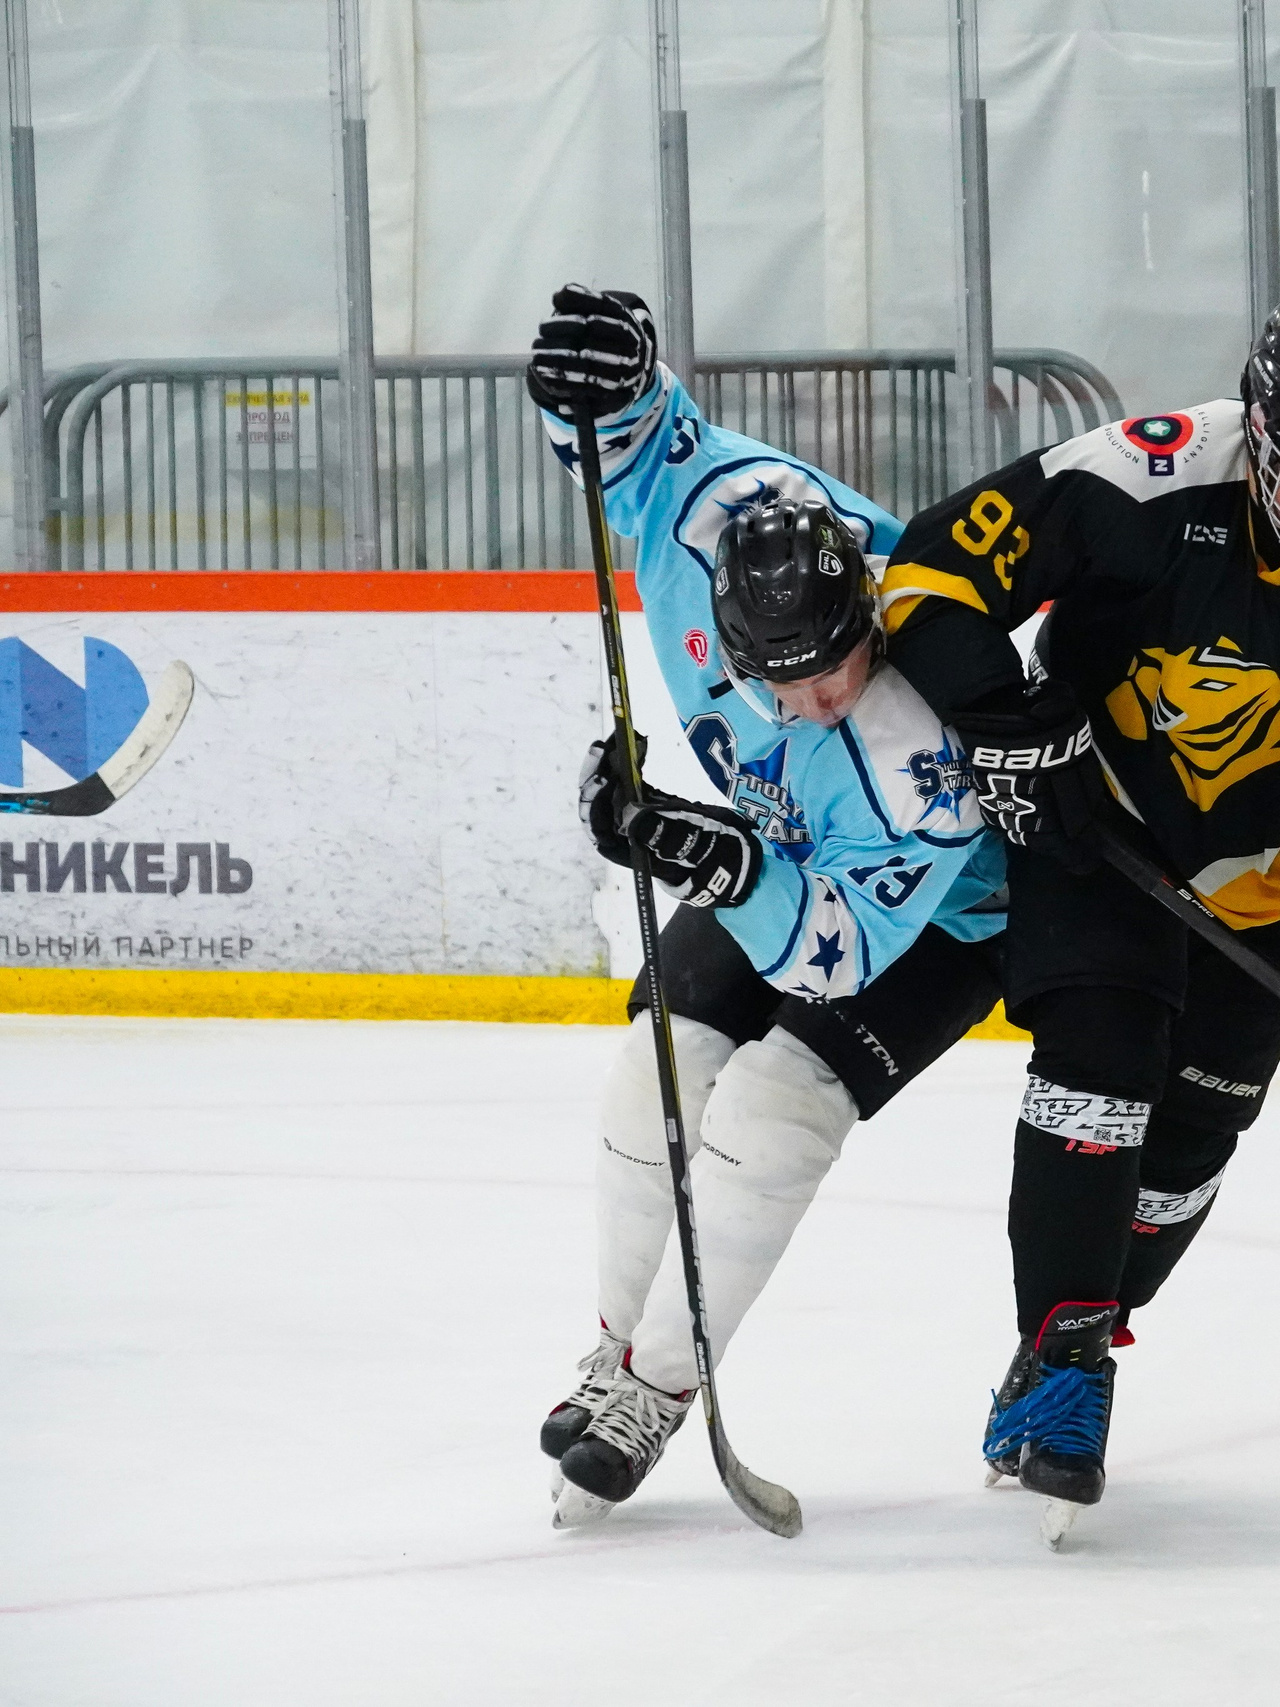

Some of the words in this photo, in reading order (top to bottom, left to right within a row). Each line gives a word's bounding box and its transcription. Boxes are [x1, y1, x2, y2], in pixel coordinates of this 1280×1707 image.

[242, 411, 291, 424] ПРООД
[1104, 427, 1140, 463] SOLUTION
[1183, 409, 1210, 463] ELLIGENT
[767, 650, 817, 667] CCM
[972, 720, 1092, 770] BAUE
[0, 842, 253, 895] НИКЕЛЬ
[116, 937, 254, 959] ПАРТНЕР
[1179, 1066, 1262, 1098] BAUER
[1056, 1309, 1111, 1327] VAPOR
